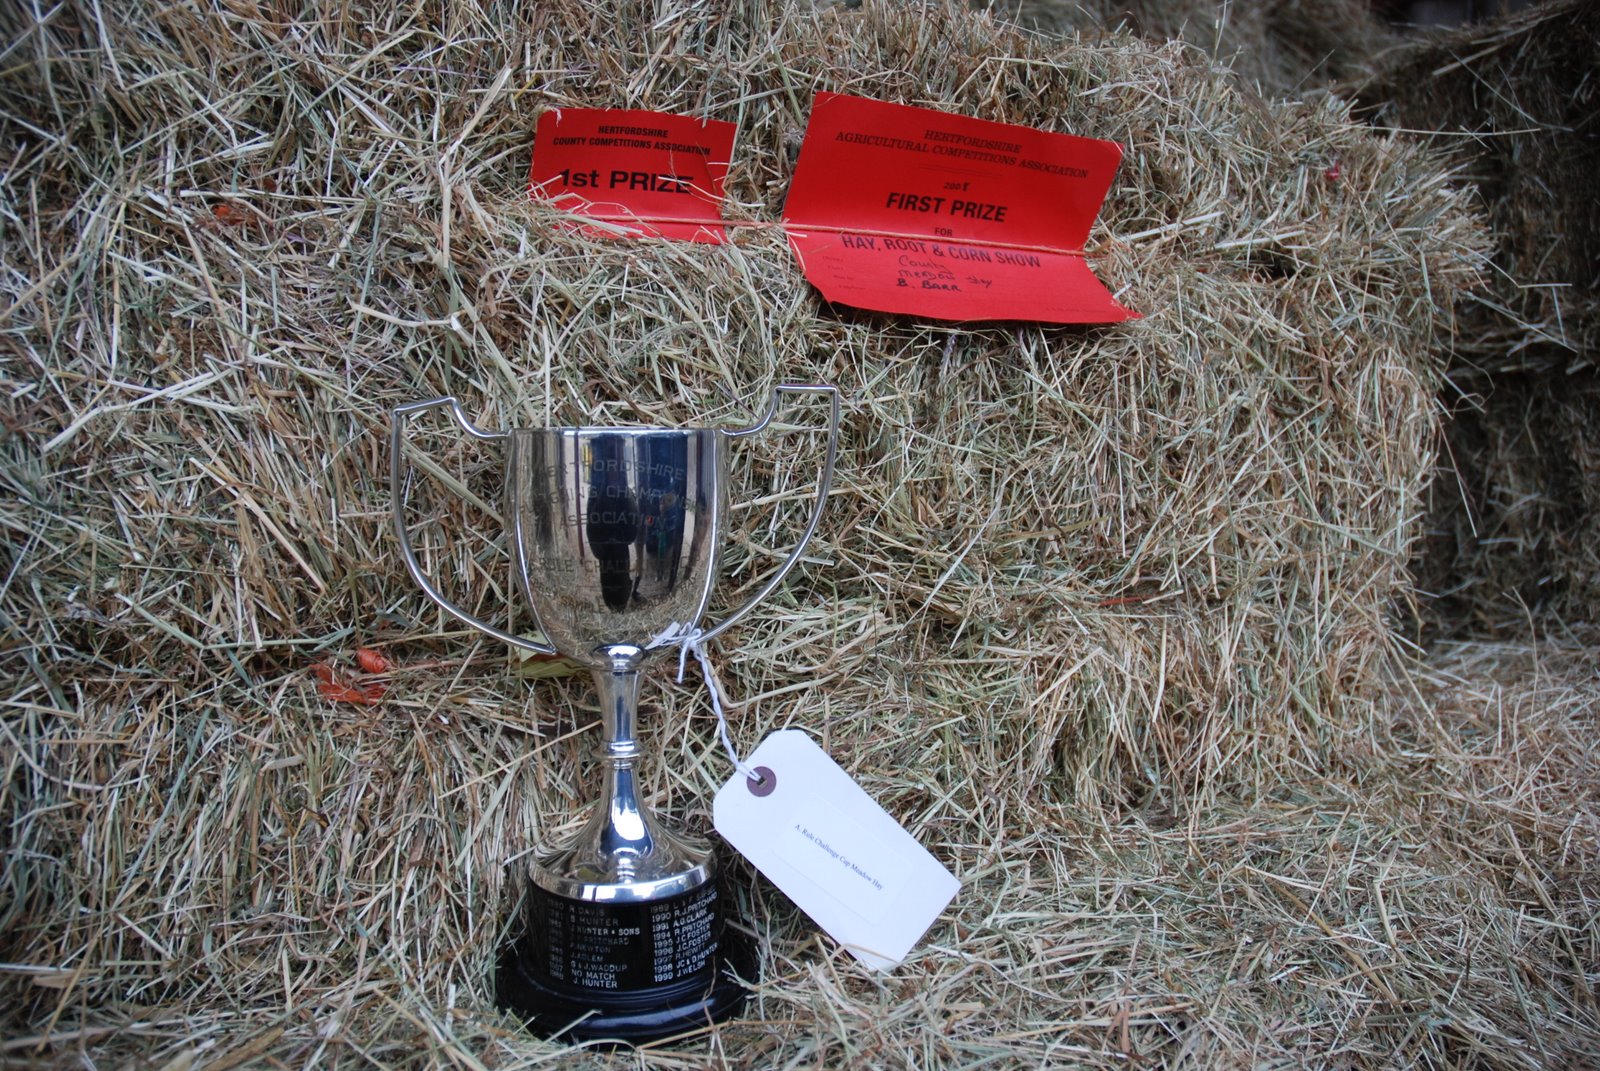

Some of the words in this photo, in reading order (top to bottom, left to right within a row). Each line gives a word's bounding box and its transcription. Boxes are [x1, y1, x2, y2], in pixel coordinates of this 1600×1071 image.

[598, 126, 668, 138] HERTFORDSHIRE
[553, 137, 585, 146] COUNTY
[589, 137, 651, 149] COMPETITIONS
[655, 141, 711, 156] ASSOCIATION
[924, 130, 1022, 154] HERTFORDSHIRE
[835, 131, 929, 154] AGRICULTURAL
[932, 144, 1016, 166] COMPETITIONS
[1018, 158, 1088, 179] ASSOCIATION
[561, 169, 599, 188] 1st
[610, 170, 694, 195] PRIZE
[886, 192, 946, 214] FIRST
[950, 199, 1009, 223] PRIZE
[934, 227, 953, 238] FOR
[883, 238, 926, 255] ROOT
[932, 245, 946, 258] &
[948, 246, 991, 263] CORN
[995, 251, 1041, 268] SHOW
[814, 837, 840, 859] Challenge
[839, 855, 851, 867] Cup
[850, 863, 872, 882] Meadow
[872, 879, 883, 891] Hay
[652, 912, 671, 923] 1990
[618, 927, 640, 936] SONS
[652, 922, 670, 932] 1991
[653, 931, 671, 941] 1994
[571, 968, 583, 978] NO
[586, 971, 616, 981] MATCH
[654, 971, 673, 982] 1999
[582, 978, 618, 989] HUNTER
